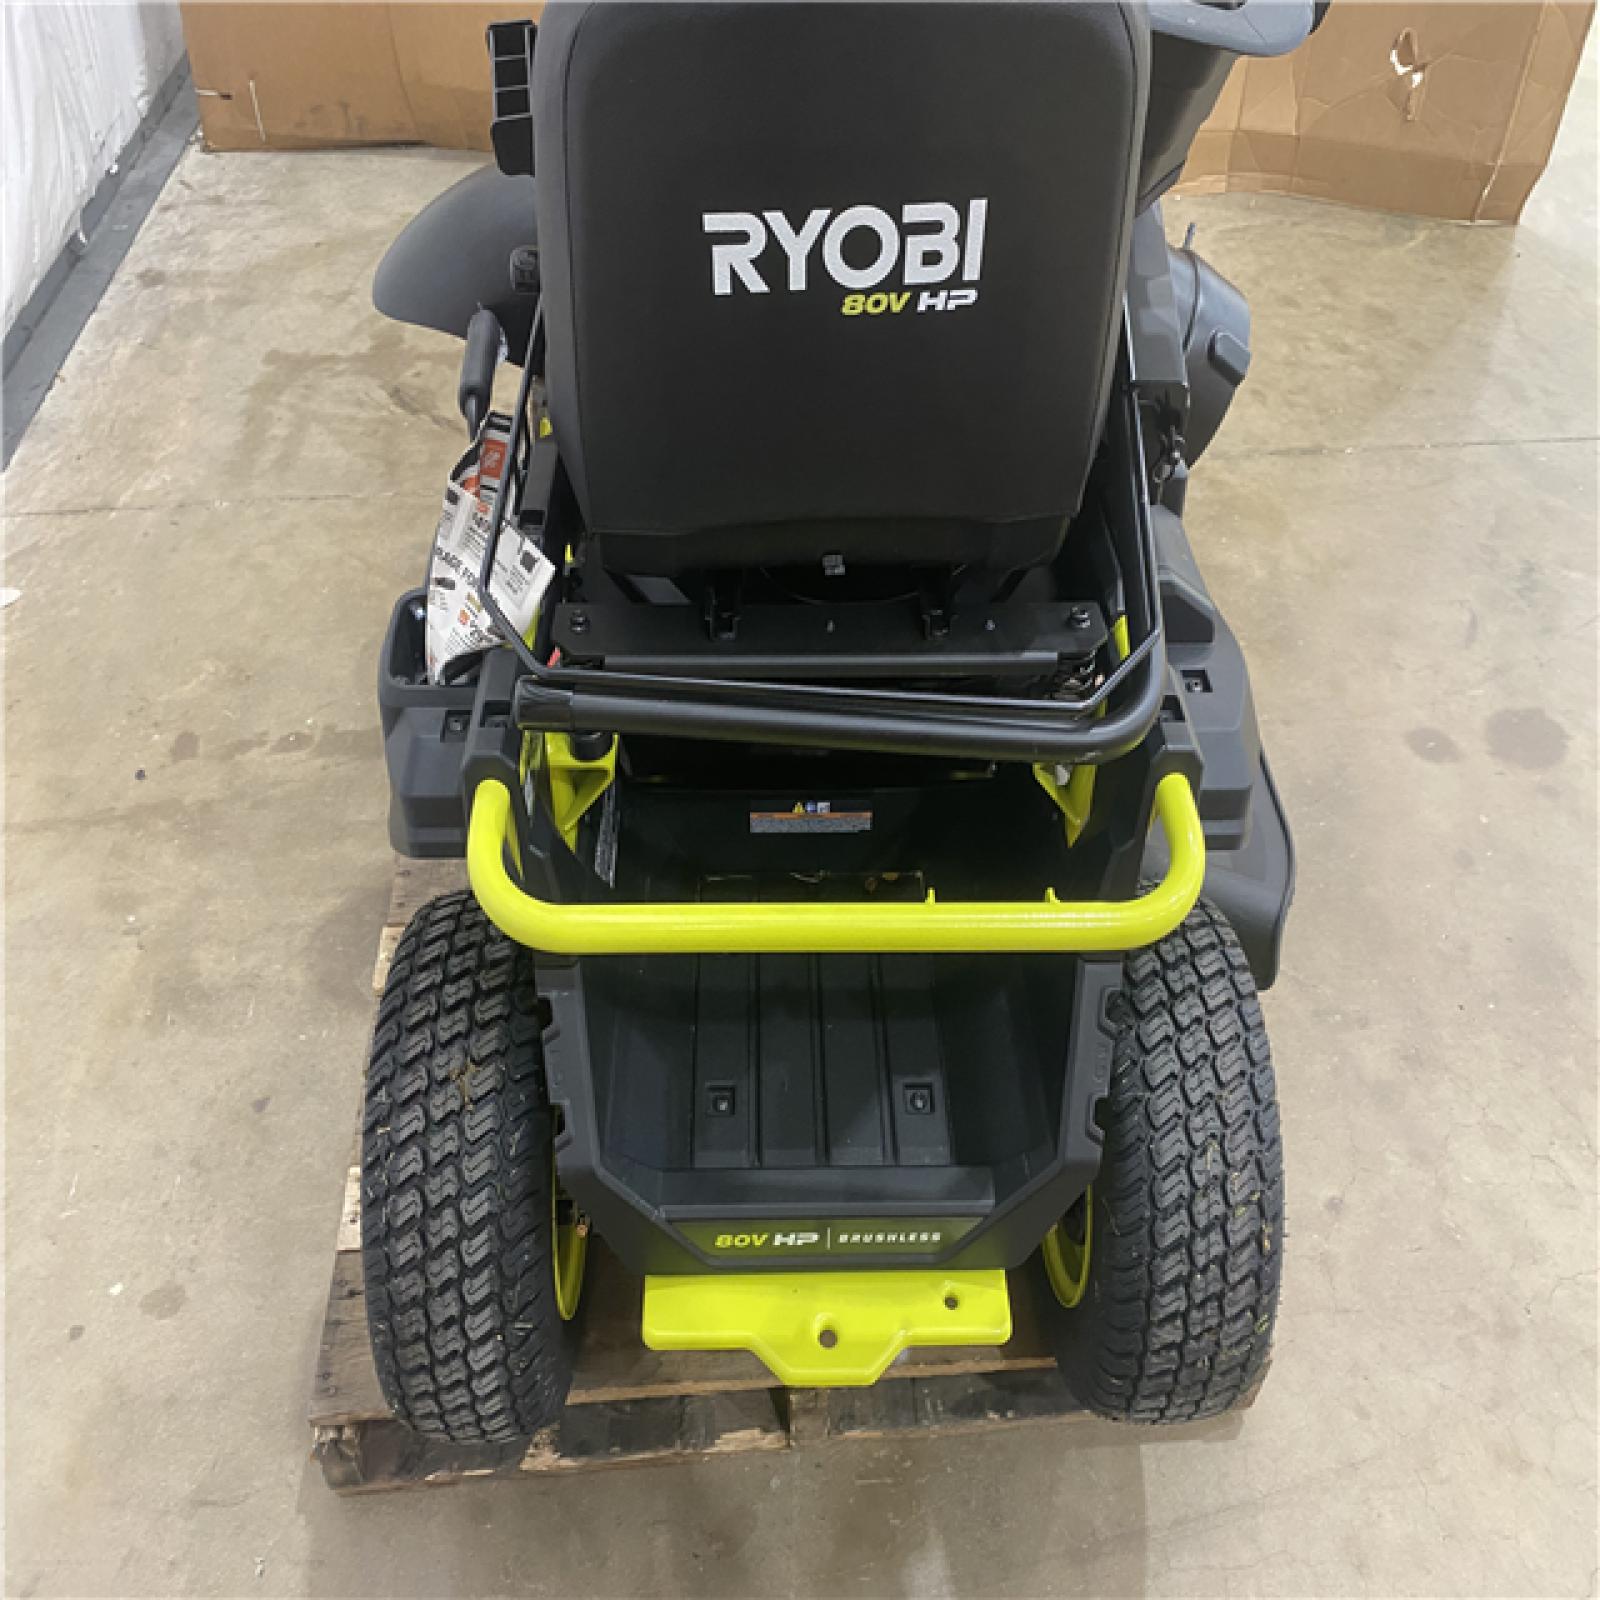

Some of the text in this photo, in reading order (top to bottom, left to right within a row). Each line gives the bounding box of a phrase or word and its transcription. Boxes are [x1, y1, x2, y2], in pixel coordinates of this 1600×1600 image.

[702, 197, 988, 296] RYOBI
[841, 288, 979, 316] 80V HP
[714, 1233, 769, 1248] 80V
[773, 1232, 820, 1246] HP
